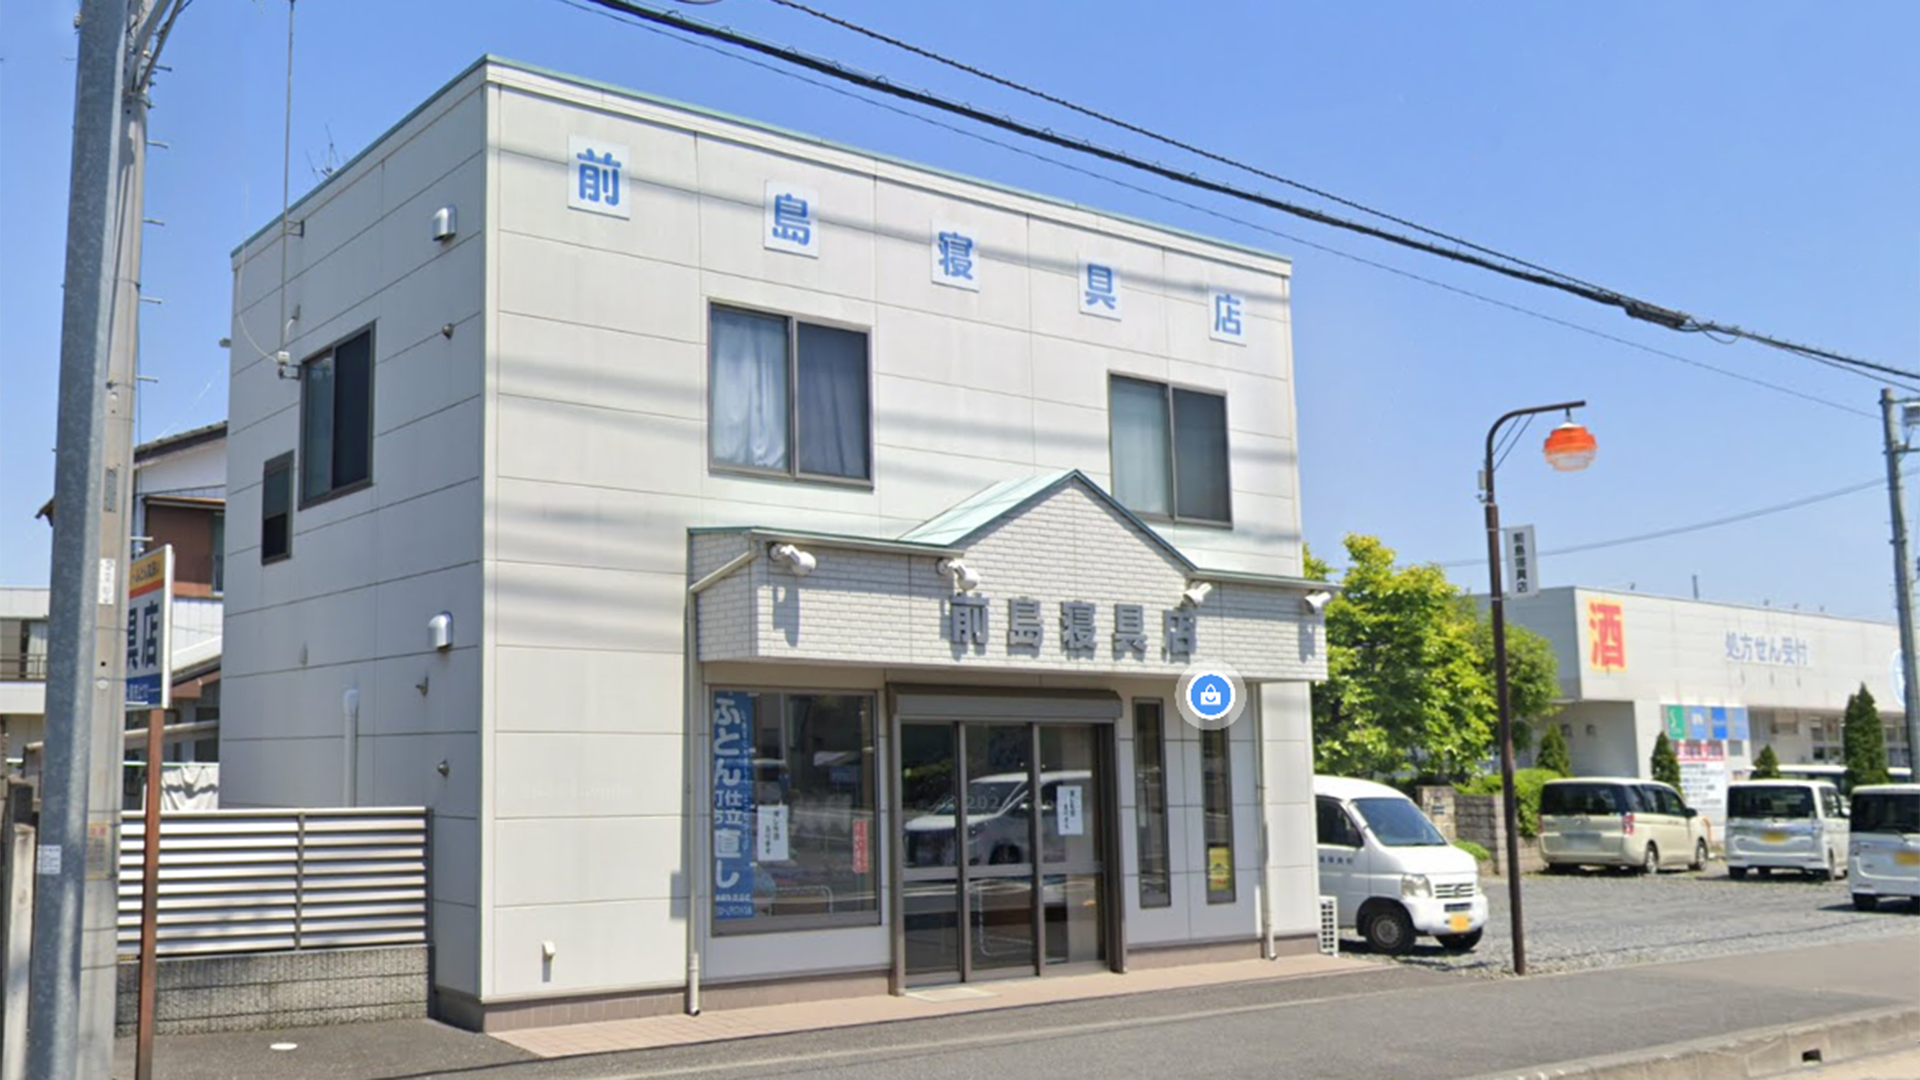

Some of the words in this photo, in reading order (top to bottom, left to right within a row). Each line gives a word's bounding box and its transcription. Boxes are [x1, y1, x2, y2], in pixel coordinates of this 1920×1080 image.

[576, 147, 1243, 336] 前島寝具店
[950, 592, 1198, 656] 前島寝具店
[1589, 602, 1624, 668] 酒
[1725, 631, 1808, 666] 処方せん受付
